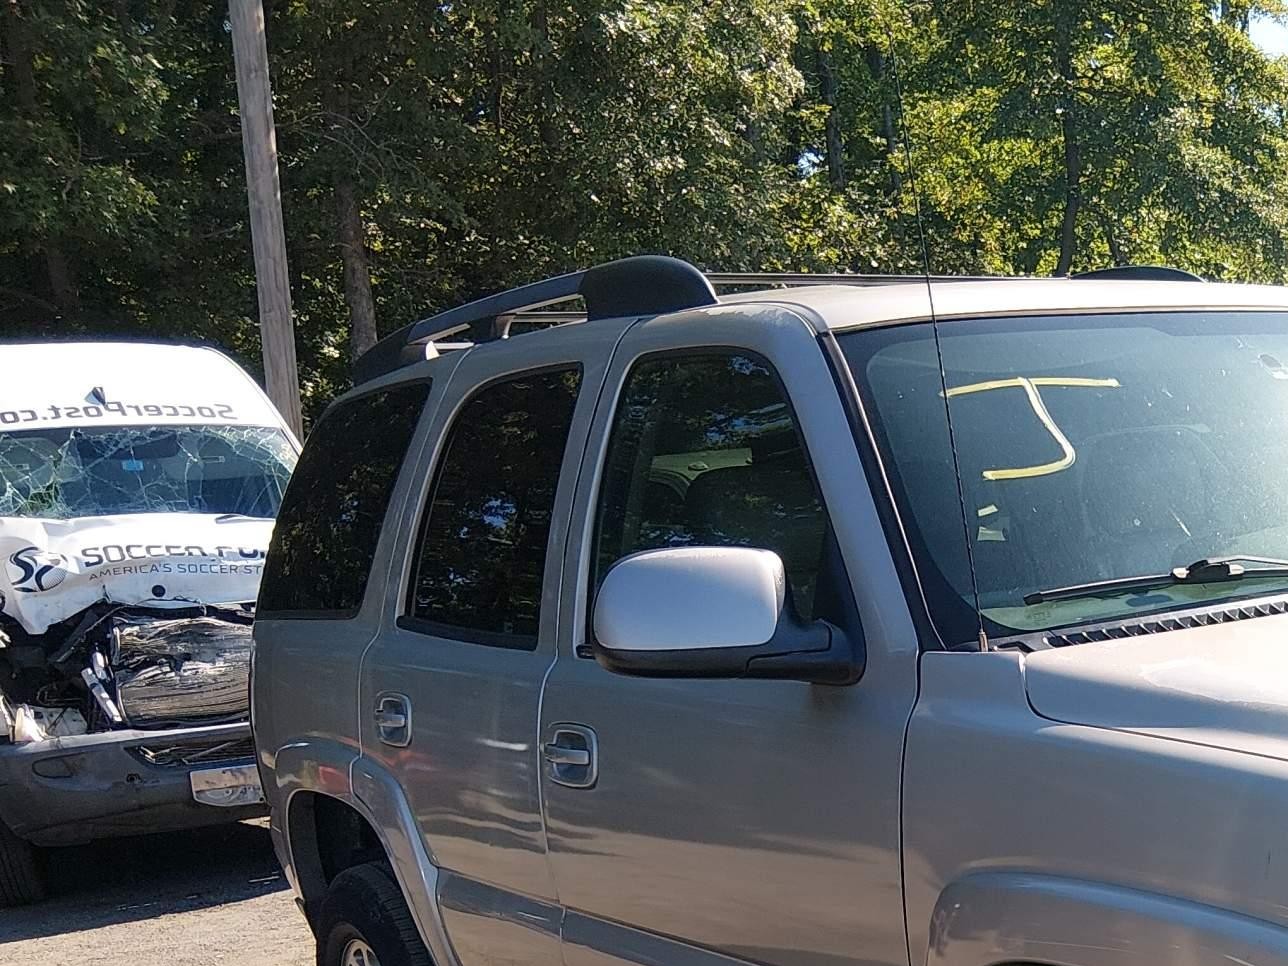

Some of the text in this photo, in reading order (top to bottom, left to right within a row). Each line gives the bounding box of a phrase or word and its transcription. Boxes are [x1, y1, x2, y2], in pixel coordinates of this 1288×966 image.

[81, 544, 208, 567] SOCCER
[88, 563, 172, 581] AMERICA'S
[177, 563, 239, 575] SOCCER
